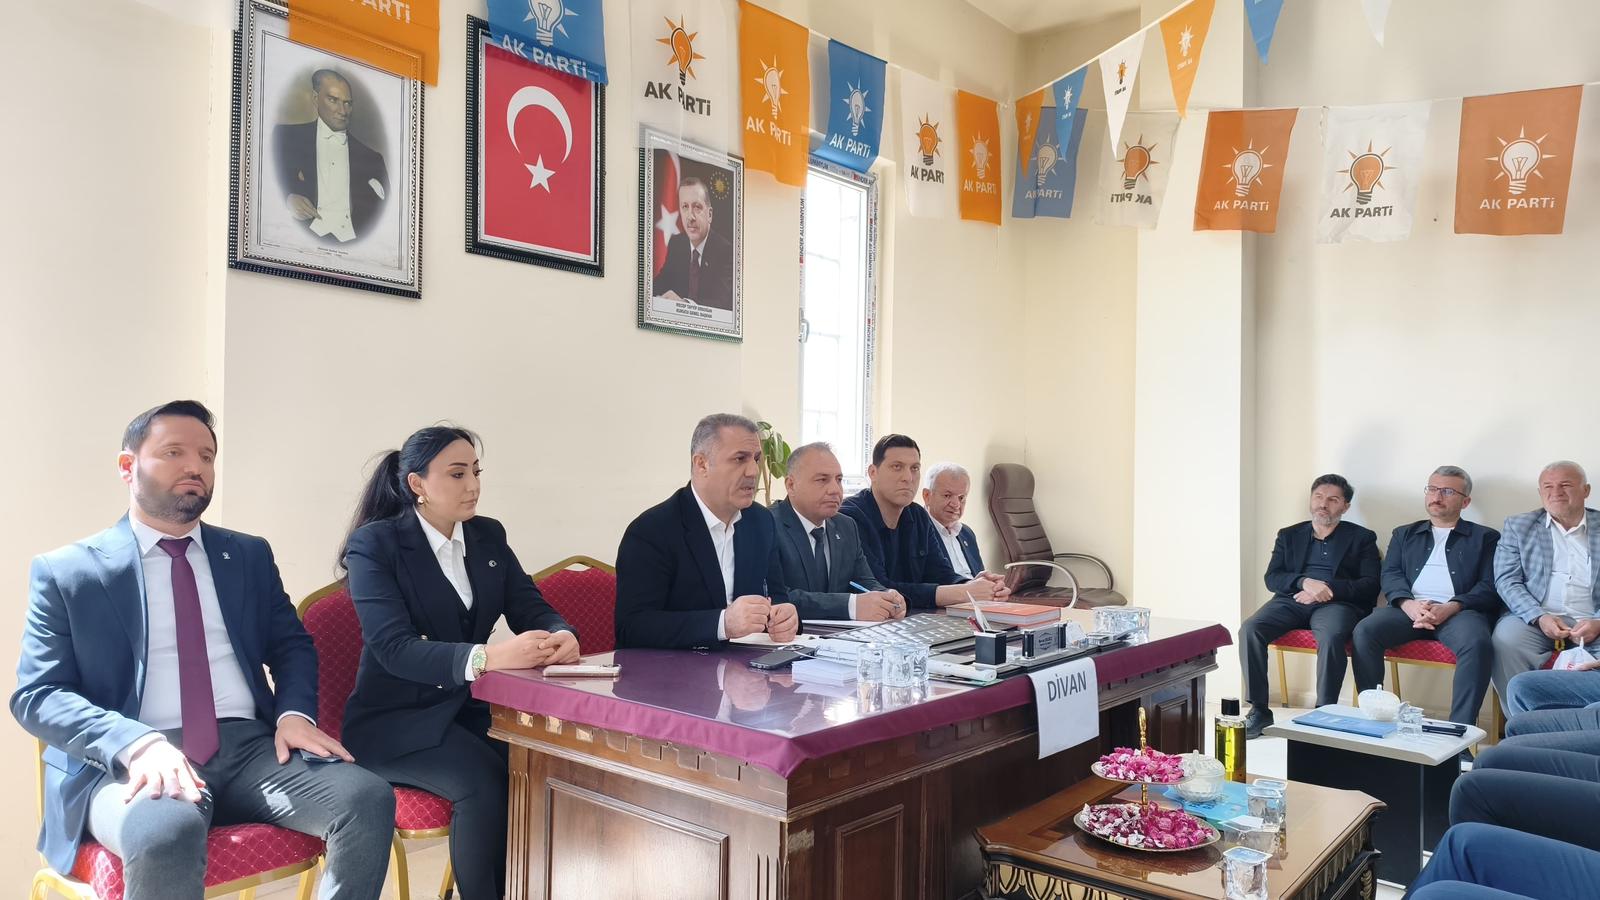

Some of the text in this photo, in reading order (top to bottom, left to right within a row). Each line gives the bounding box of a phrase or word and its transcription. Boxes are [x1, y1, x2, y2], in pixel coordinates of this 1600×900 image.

[350, 0, 411, 24] RTi
[502, 34, 588, 79] AK PARTi
[644, 81, 673, 101] AK
[746, 116, 765, 134] AK
[829, 133, 871, 158] AK PARTi
[910, 164, 945, 185] AK PART
[963, 178, 974, 192] AK
[1037, 189, 1063, 199] ARTi
[1213, 199, 1269, 211] AK PARTi
[1329, 205, 1393, 218] AK PARTi
[1480, 197, 1556, 210] AK PARTi
[1047, 670, 1087, 702] DİVAN
